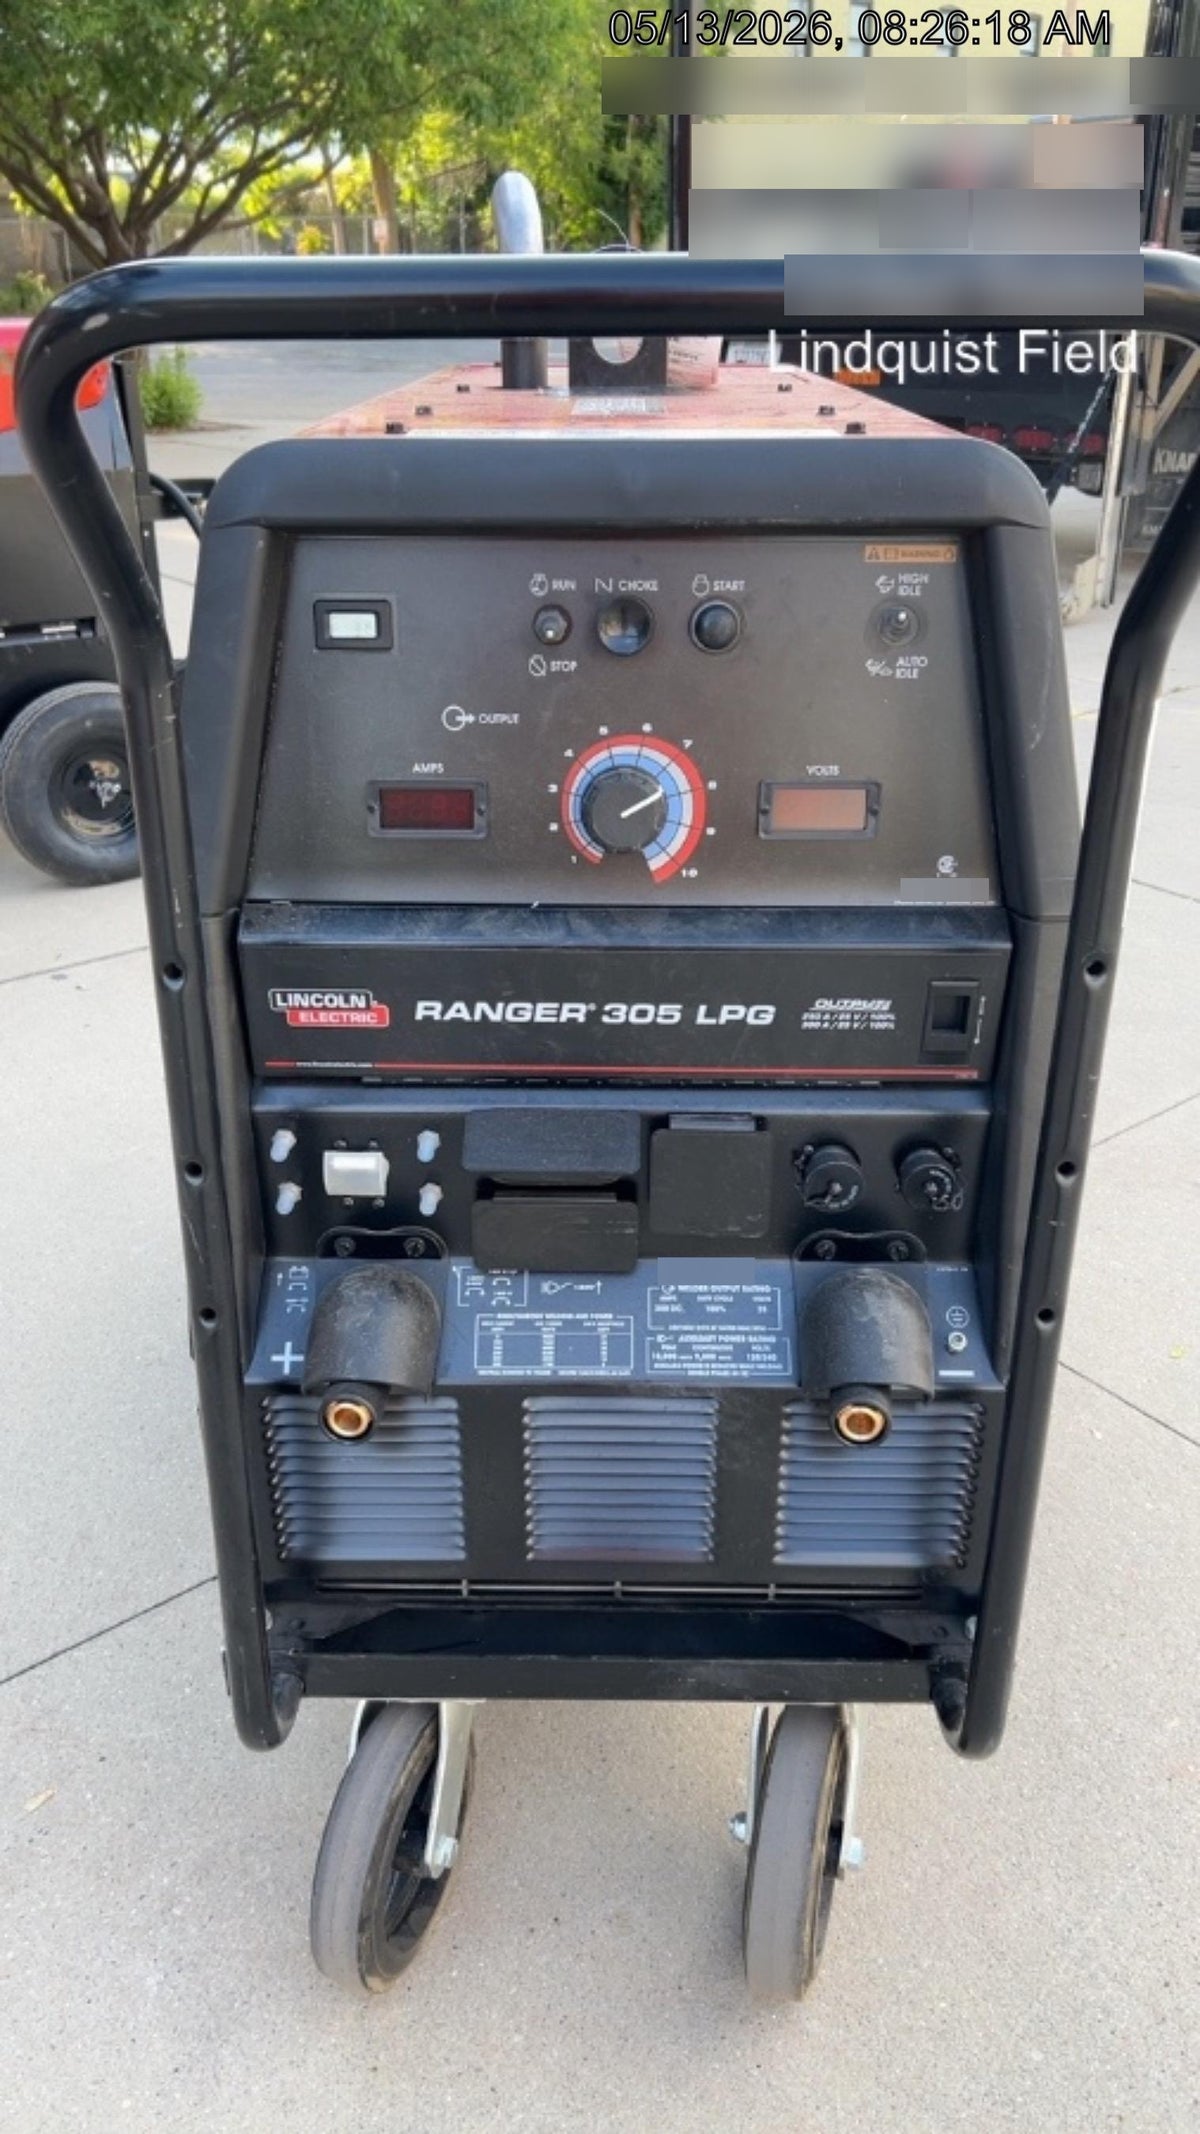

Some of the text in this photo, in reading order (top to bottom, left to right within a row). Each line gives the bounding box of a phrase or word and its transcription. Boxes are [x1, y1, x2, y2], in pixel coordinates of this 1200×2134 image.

[898, 573, 930, 584] HIGH
[552, 579, 577, 591] RUN
[618, 579, 659, 591] CHOKE
[713, 579, 745, 591] START
[898, 585, 921, 596] IDLE
[550, 660, 577, 673] STOP
[896, 656, 928, 667] AUTO
[895, 667, 919, 679] IDLE
[478, 713, 520, 725] OUTPUT
[412, 762, 444, 774] AMPS
[806, 765, 840, 776] VOLTS
[276, 992, 367, 1009] LINCOLN
[299, 1011, 379, 1024] ELECTRIC
[414, 1000, 777, 1026] RANGER 305 LPG
